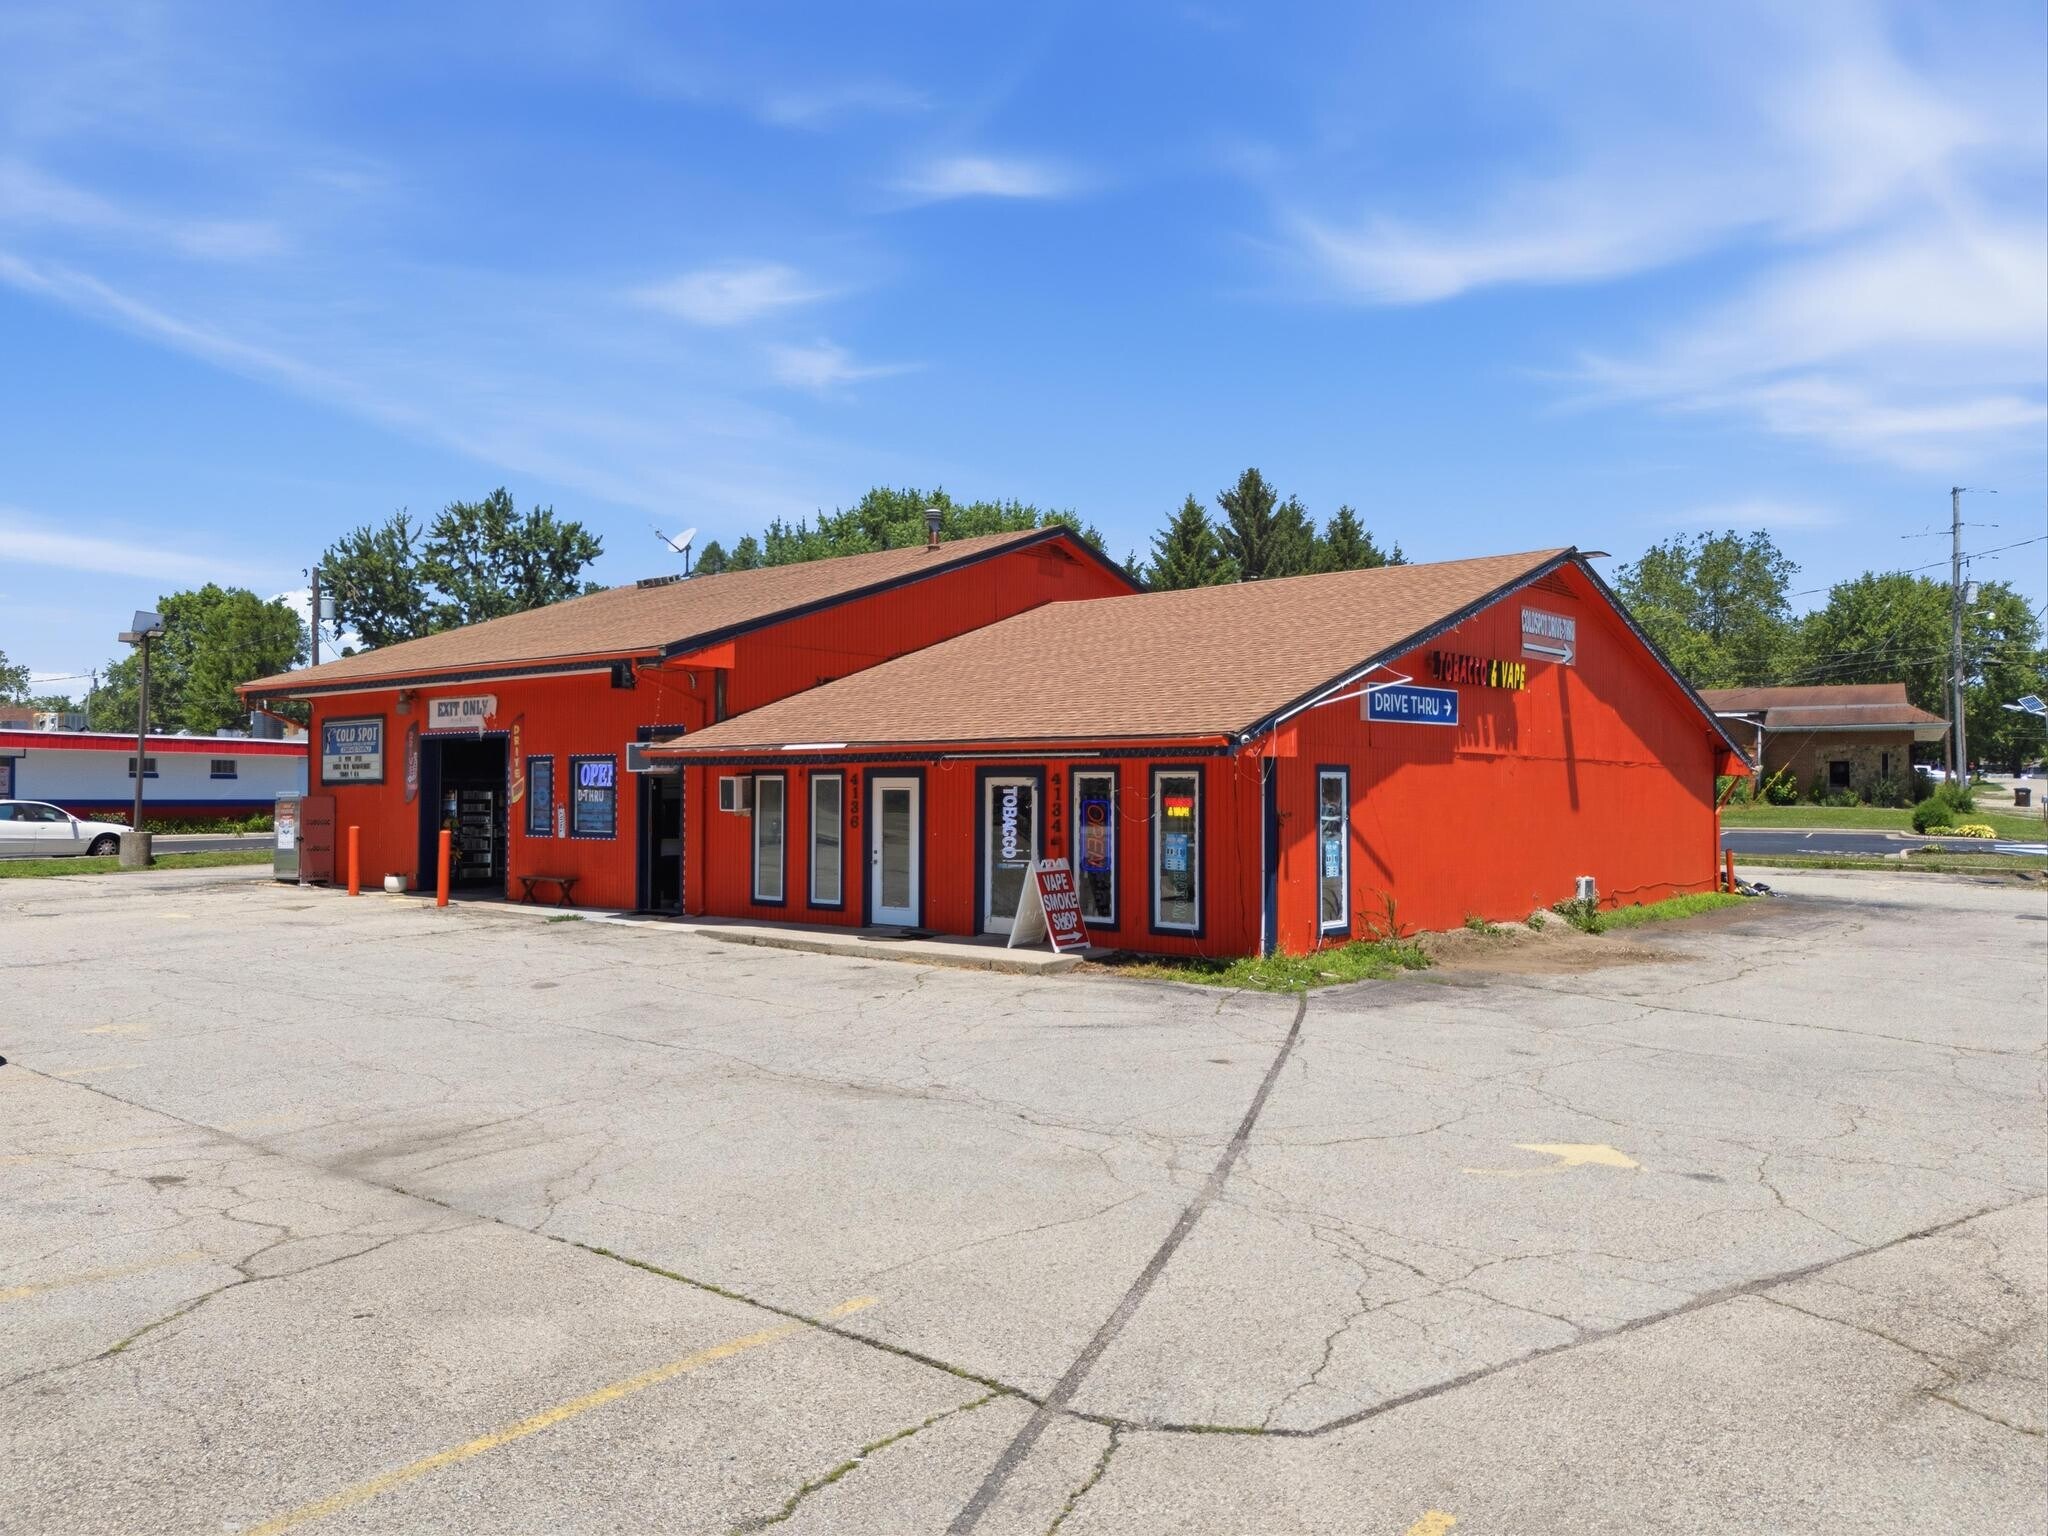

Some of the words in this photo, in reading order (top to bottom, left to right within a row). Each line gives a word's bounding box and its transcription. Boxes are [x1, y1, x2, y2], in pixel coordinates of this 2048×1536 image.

[1437, 651, 1488, 686] TOBACCO
[1501, 661, 1526, 690] VAPE
[438, 702, 460, 717] EXIT
[463, 699, 488, 716] ONLY
[1375, 693, 1408, 714] DRIVE
[1411, 696, 1439, 716] THRU
[336, 728, 355, 742] COLD
[358, 727, 378, 741] SPOT
[850, 773, 859, 829] 4136
[1051, 773, 1061, 833] 4134
[1002, 787, 1018, 859] TOBACCO
[1087, 804, 1105, 868] OPEN
[1043, 873, 1069, 892] VAPE
[1043, 892, 1079, 912] SMOKE
[1052, 911, 1078, 931] SHOP
